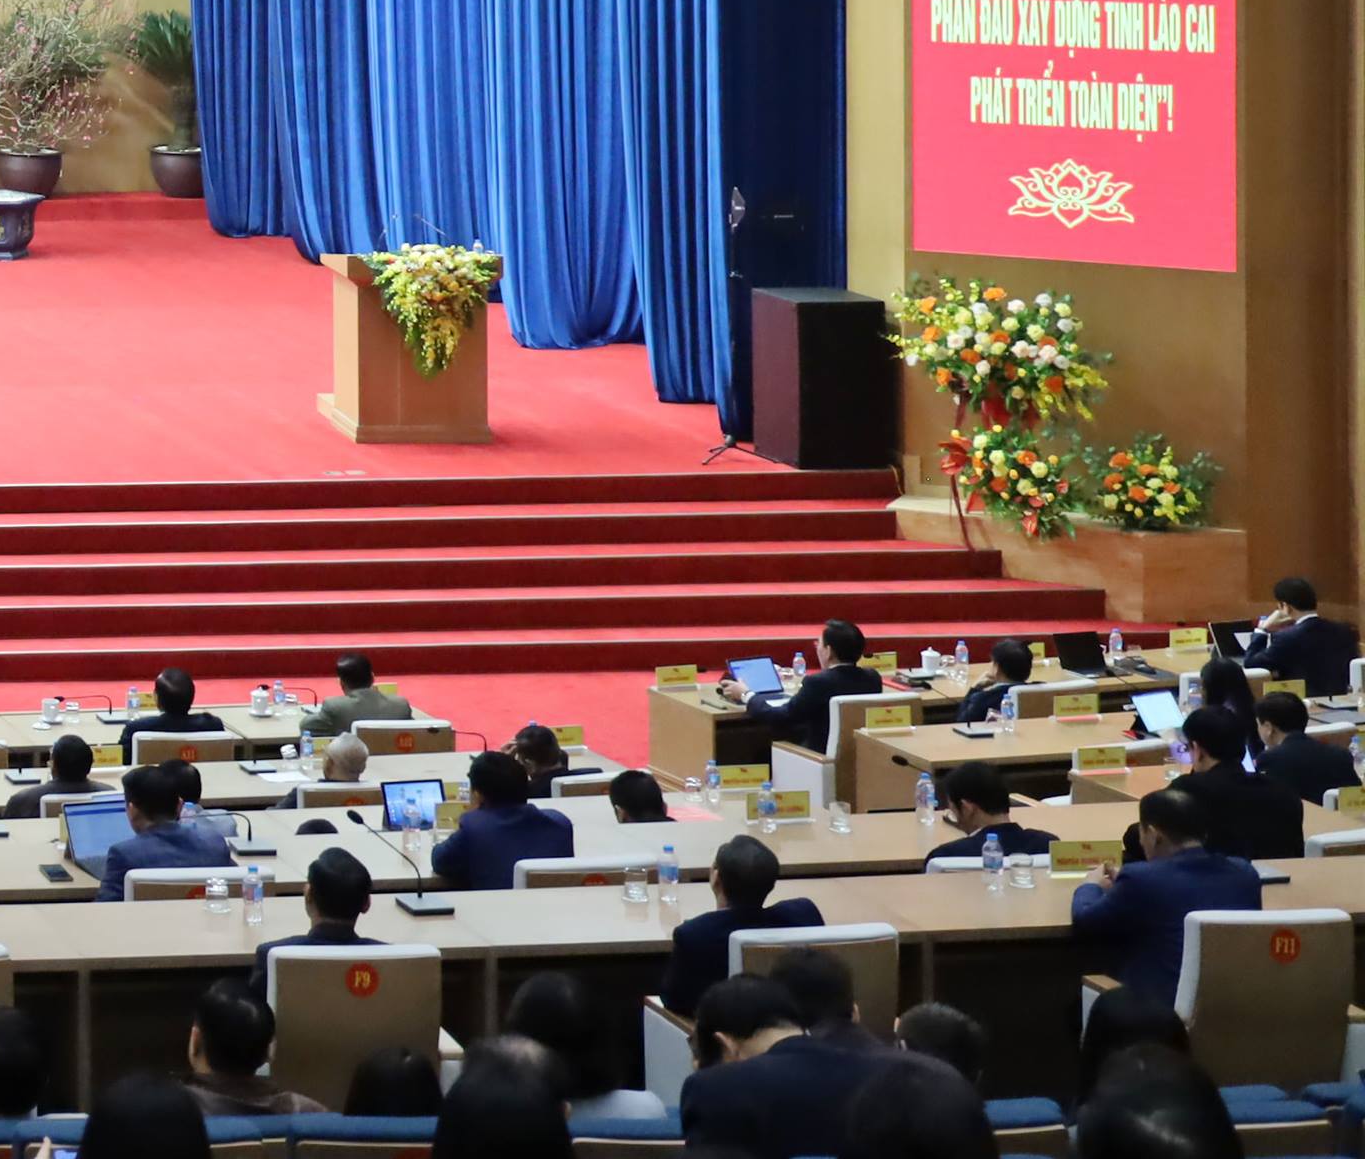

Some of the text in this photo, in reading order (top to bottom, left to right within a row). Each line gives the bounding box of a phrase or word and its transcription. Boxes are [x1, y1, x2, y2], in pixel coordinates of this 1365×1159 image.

[1186, 4, 1215, 53] CAI
[971, 68, 1013, 124] PHÁT
[1016, 60, 1065, 127] TRIỂN
[1068, 72, 1113, 129] TOÀN
[1275, 936, 1296, 955] F11
[354, 971, 371, 988] F9
